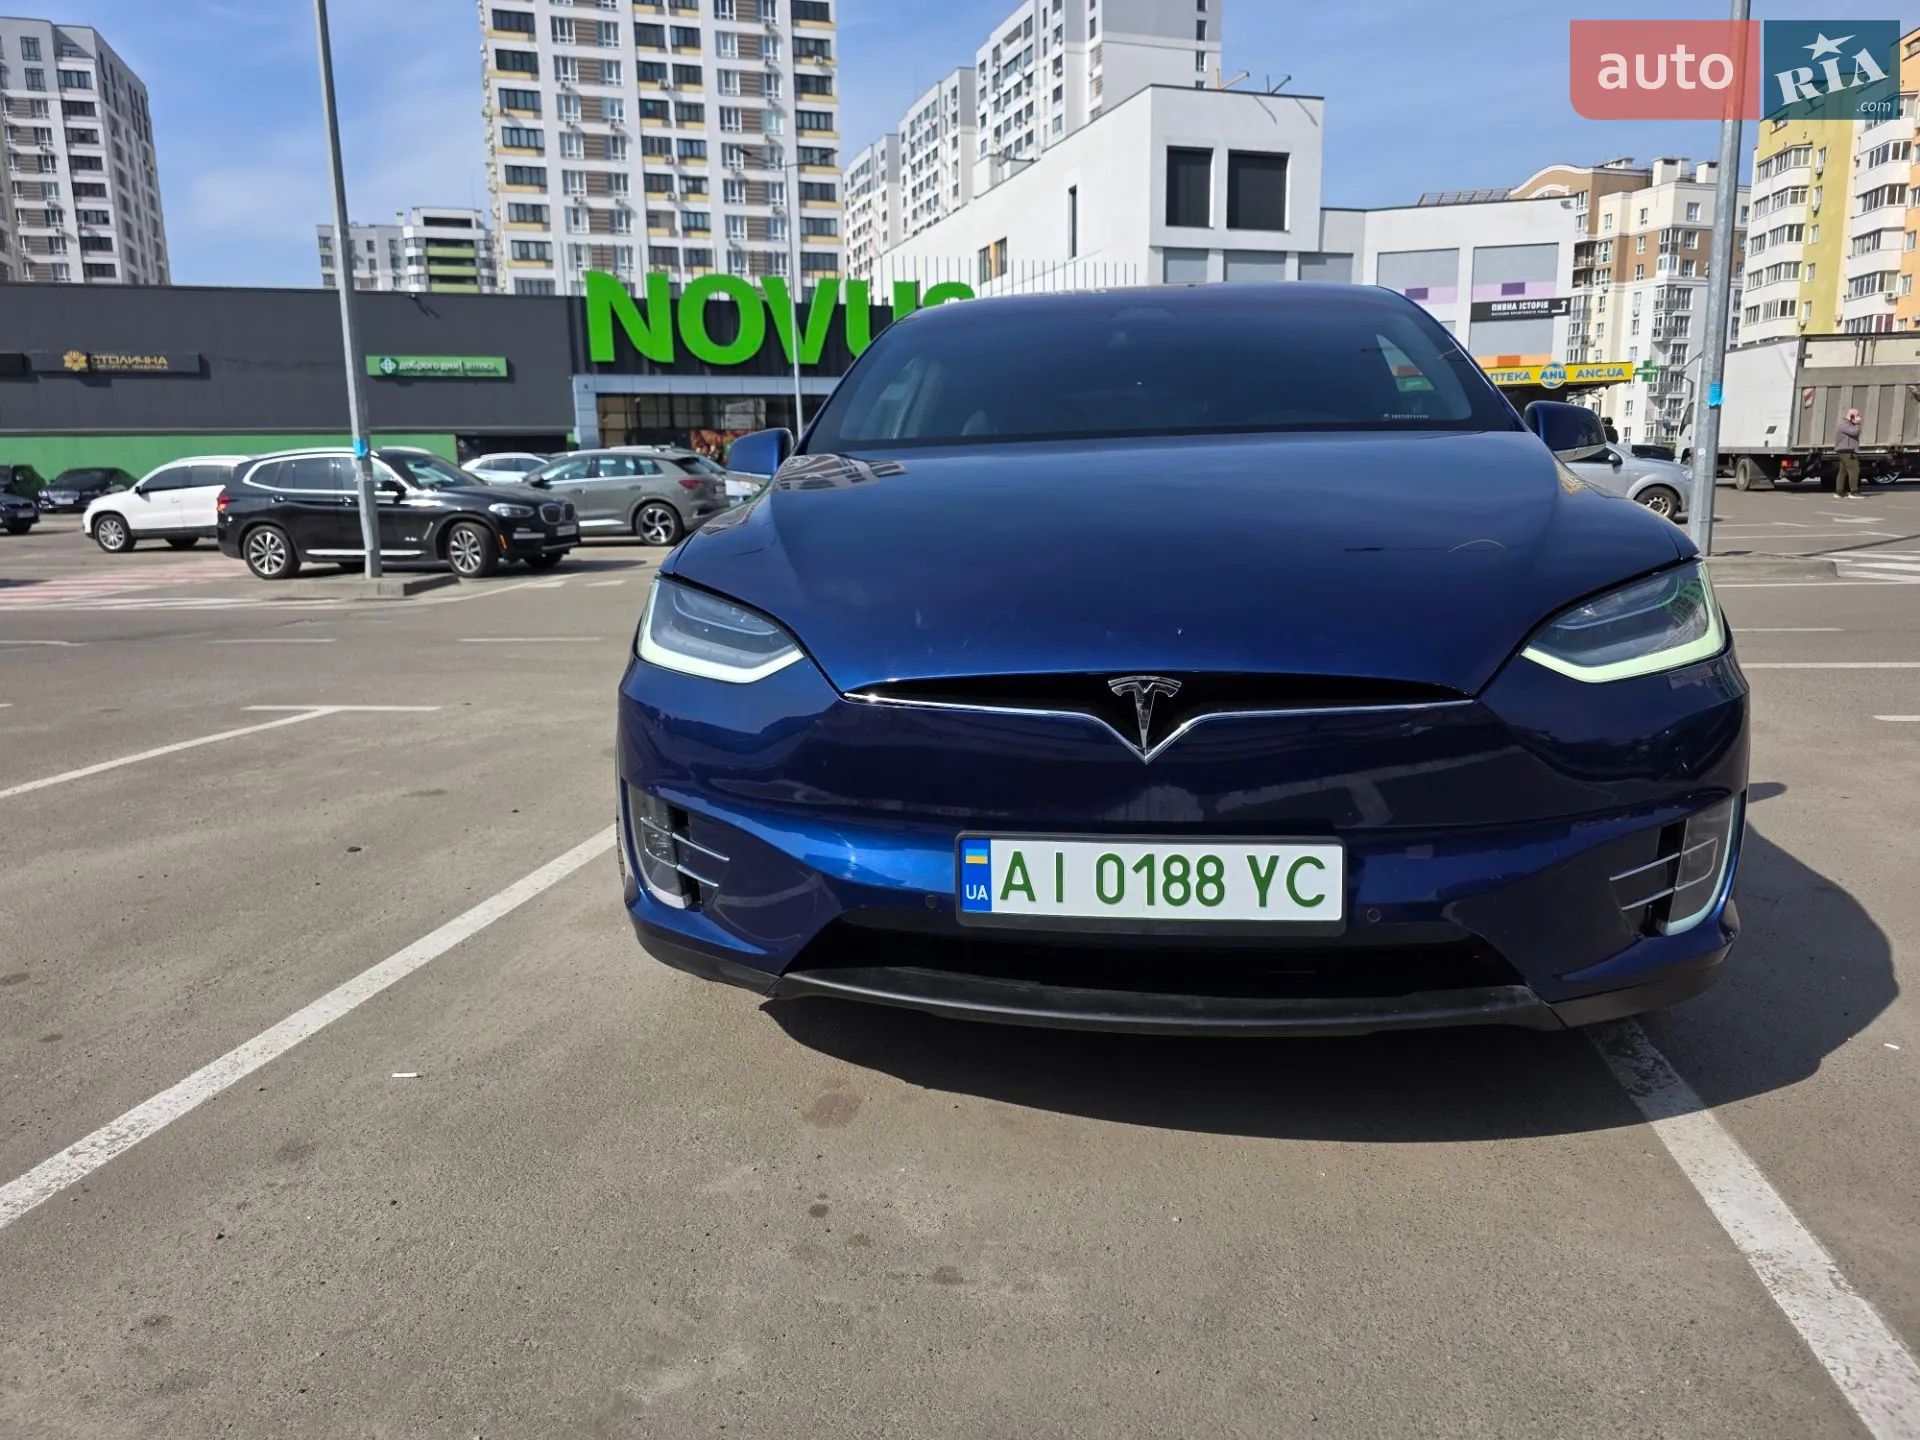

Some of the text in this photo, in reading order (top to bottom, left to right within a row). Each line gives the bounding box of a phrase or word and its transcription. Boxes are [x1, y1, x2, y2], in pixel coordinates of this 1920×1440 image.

[584, 270, 976, 365] NOVU
[1490, 371, 1532, 382] ПТЕКА
[1575, 367, 1625, 379] ANC.UA
[999, 850, 1326, 908] AI 0188 YC
[965, 884, 989, 902] UA
